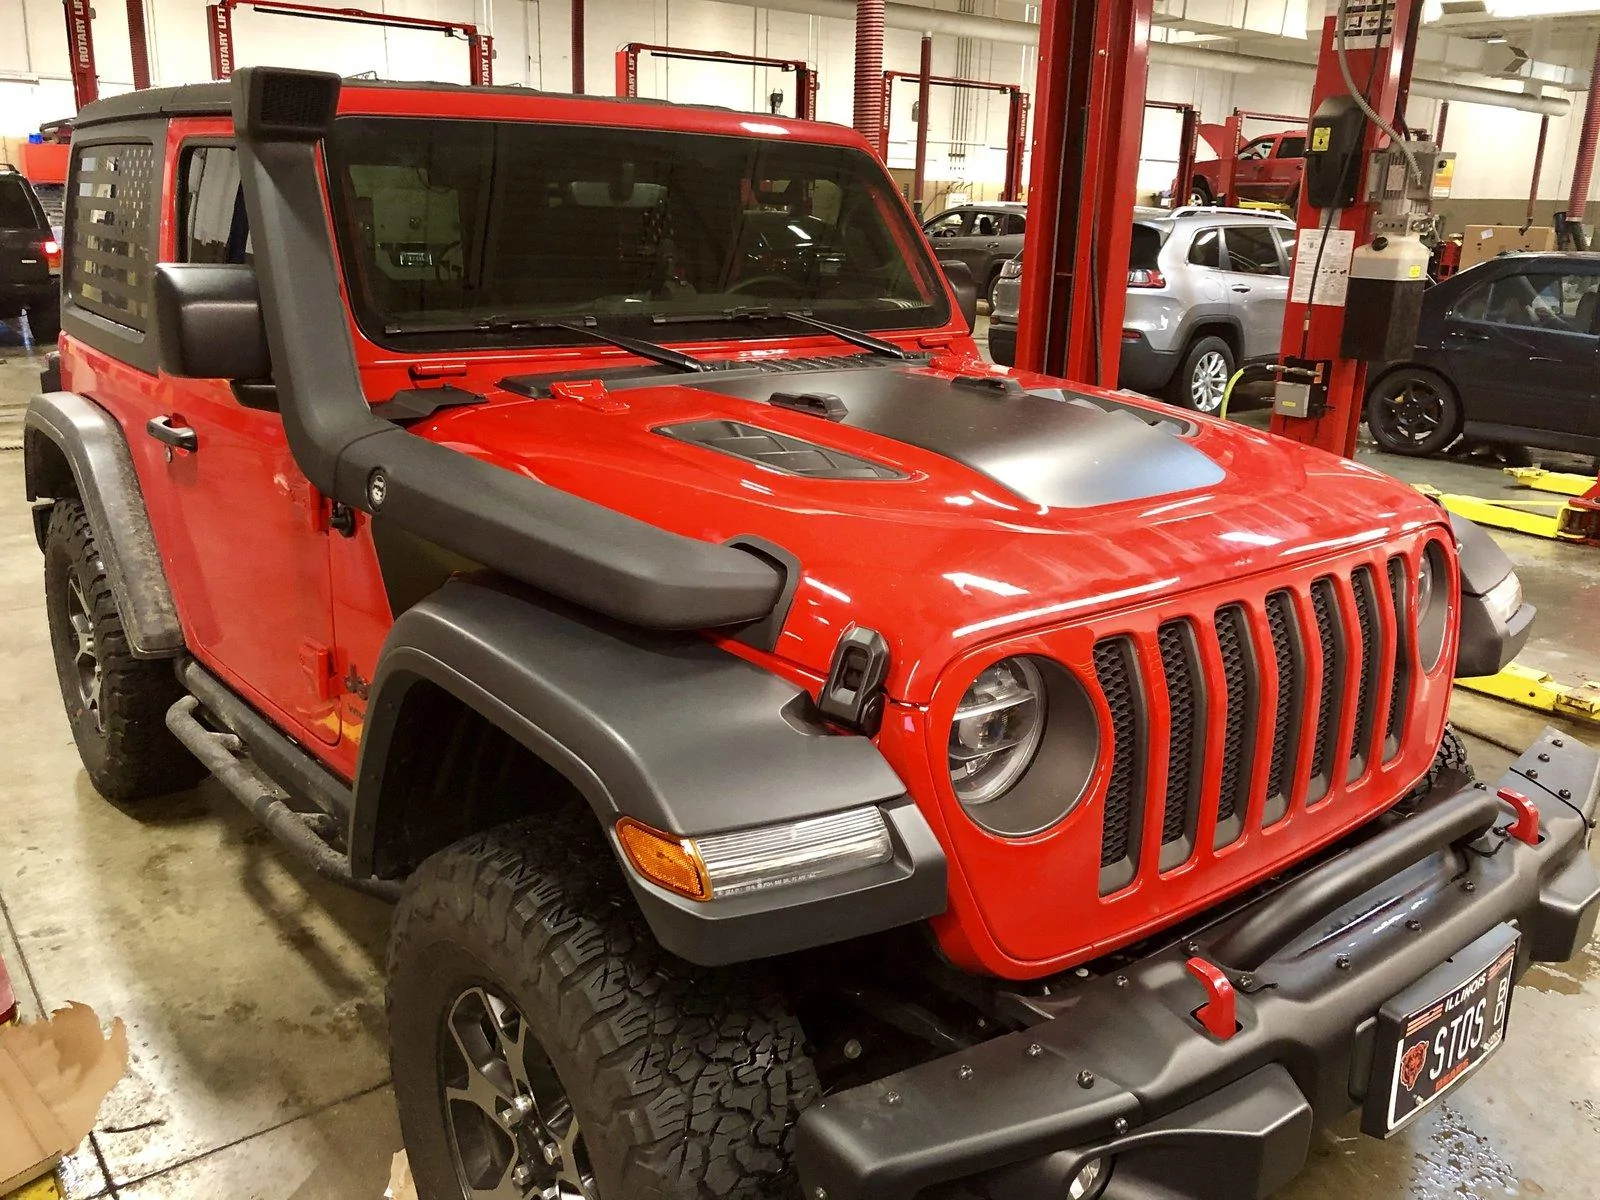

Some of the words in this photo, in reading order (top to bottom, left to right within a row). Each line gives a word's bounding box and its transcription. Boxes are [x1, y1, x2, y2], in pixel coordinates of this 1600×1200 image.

[74, 0, 84, 15] LIF
[217, 6, 227, 29] LIFT
[76, 18, 89, 63] ROTARY
[219, 31, 230, 74] ROTARY
[481, 36, 489, 56] LIFT
[1445, 972, 1487, 1012] ILLINOIS
[1430, 997, 1487, 1080] STOS
